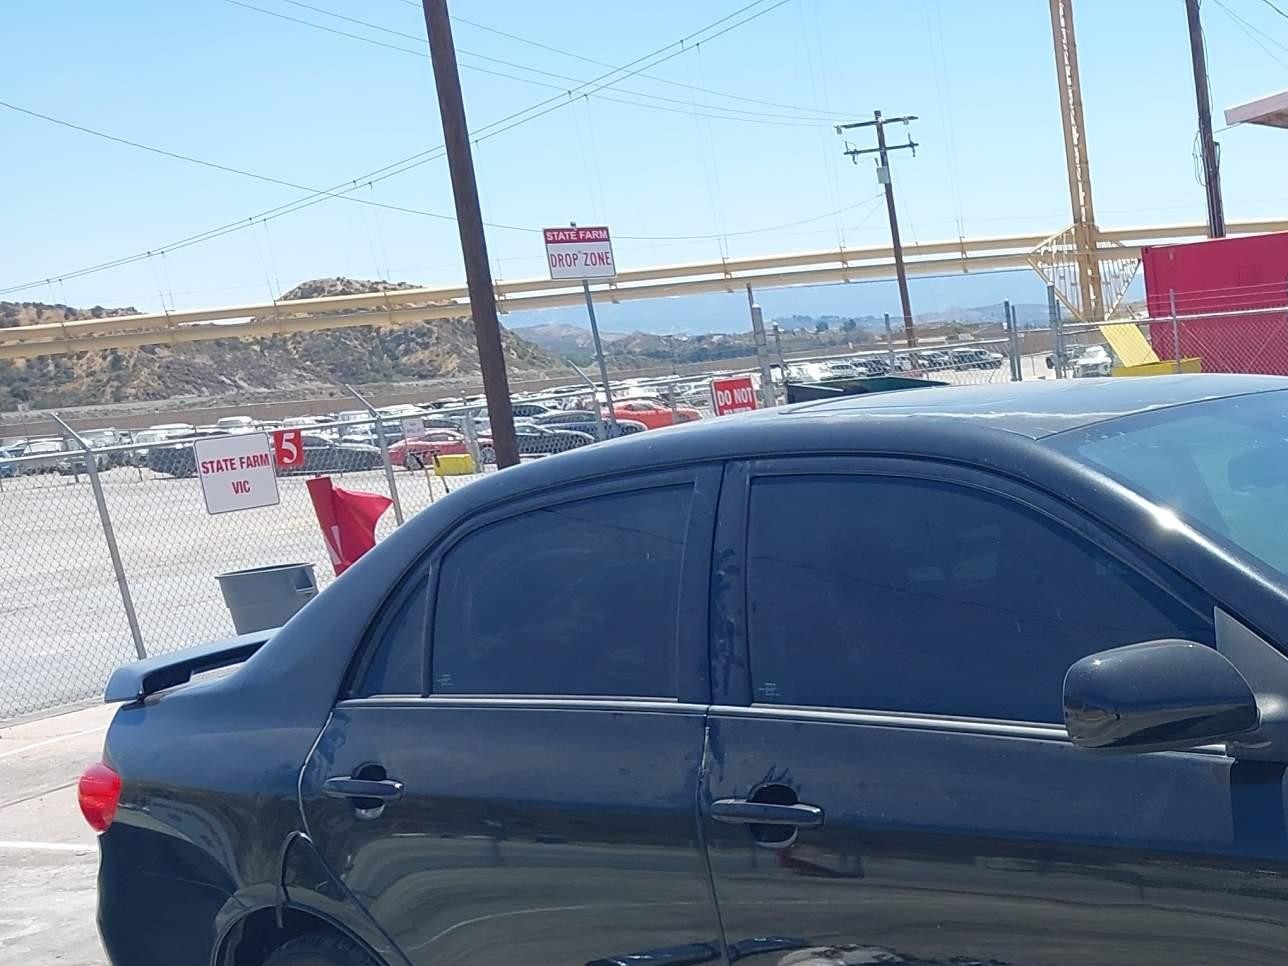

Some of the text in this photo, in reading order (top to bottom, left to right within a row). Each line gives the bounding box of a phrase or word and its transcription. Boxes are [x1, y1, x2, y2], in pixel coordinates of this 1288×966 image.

[546, 230, 608, 241] STATE FARM
[550, 251, 612, 268] DROP ZONE
[717, 387, 753, 406] DO NOT
[281, 433, 298, 464] 5
[201, 454, 270, 474] STATE FARM
[231, 480, 251, 494] VIC
